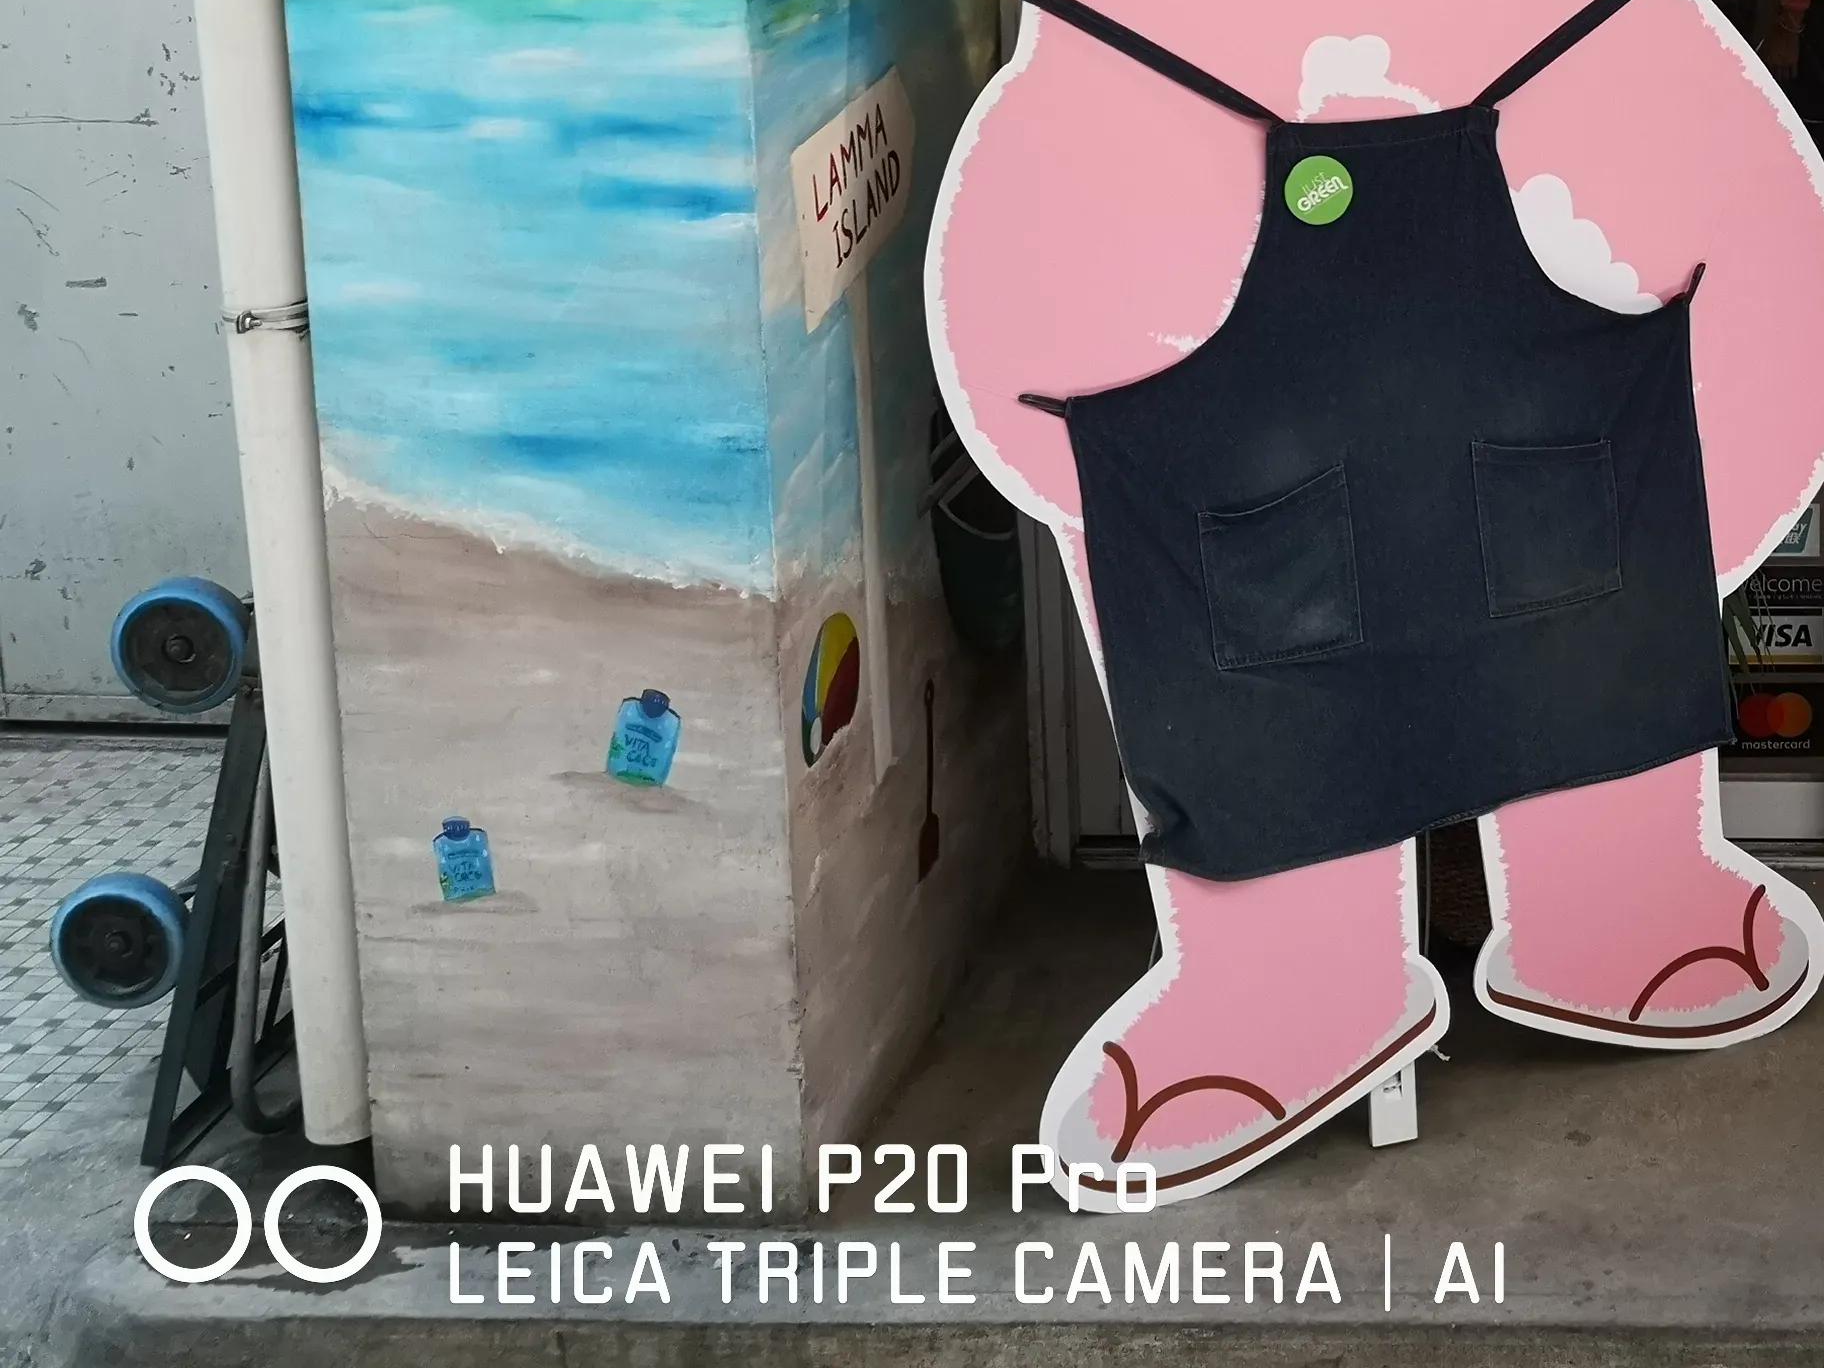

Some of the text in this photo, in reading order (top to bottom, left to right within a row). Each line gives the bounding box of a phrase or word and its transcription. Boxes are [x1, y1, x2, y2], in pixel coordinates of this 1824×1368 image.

[812, 103, 888, 223] LAMMA
[831, 149, 901, 269] ISLAND
[1742, 739, 1811, 750] mastercard
